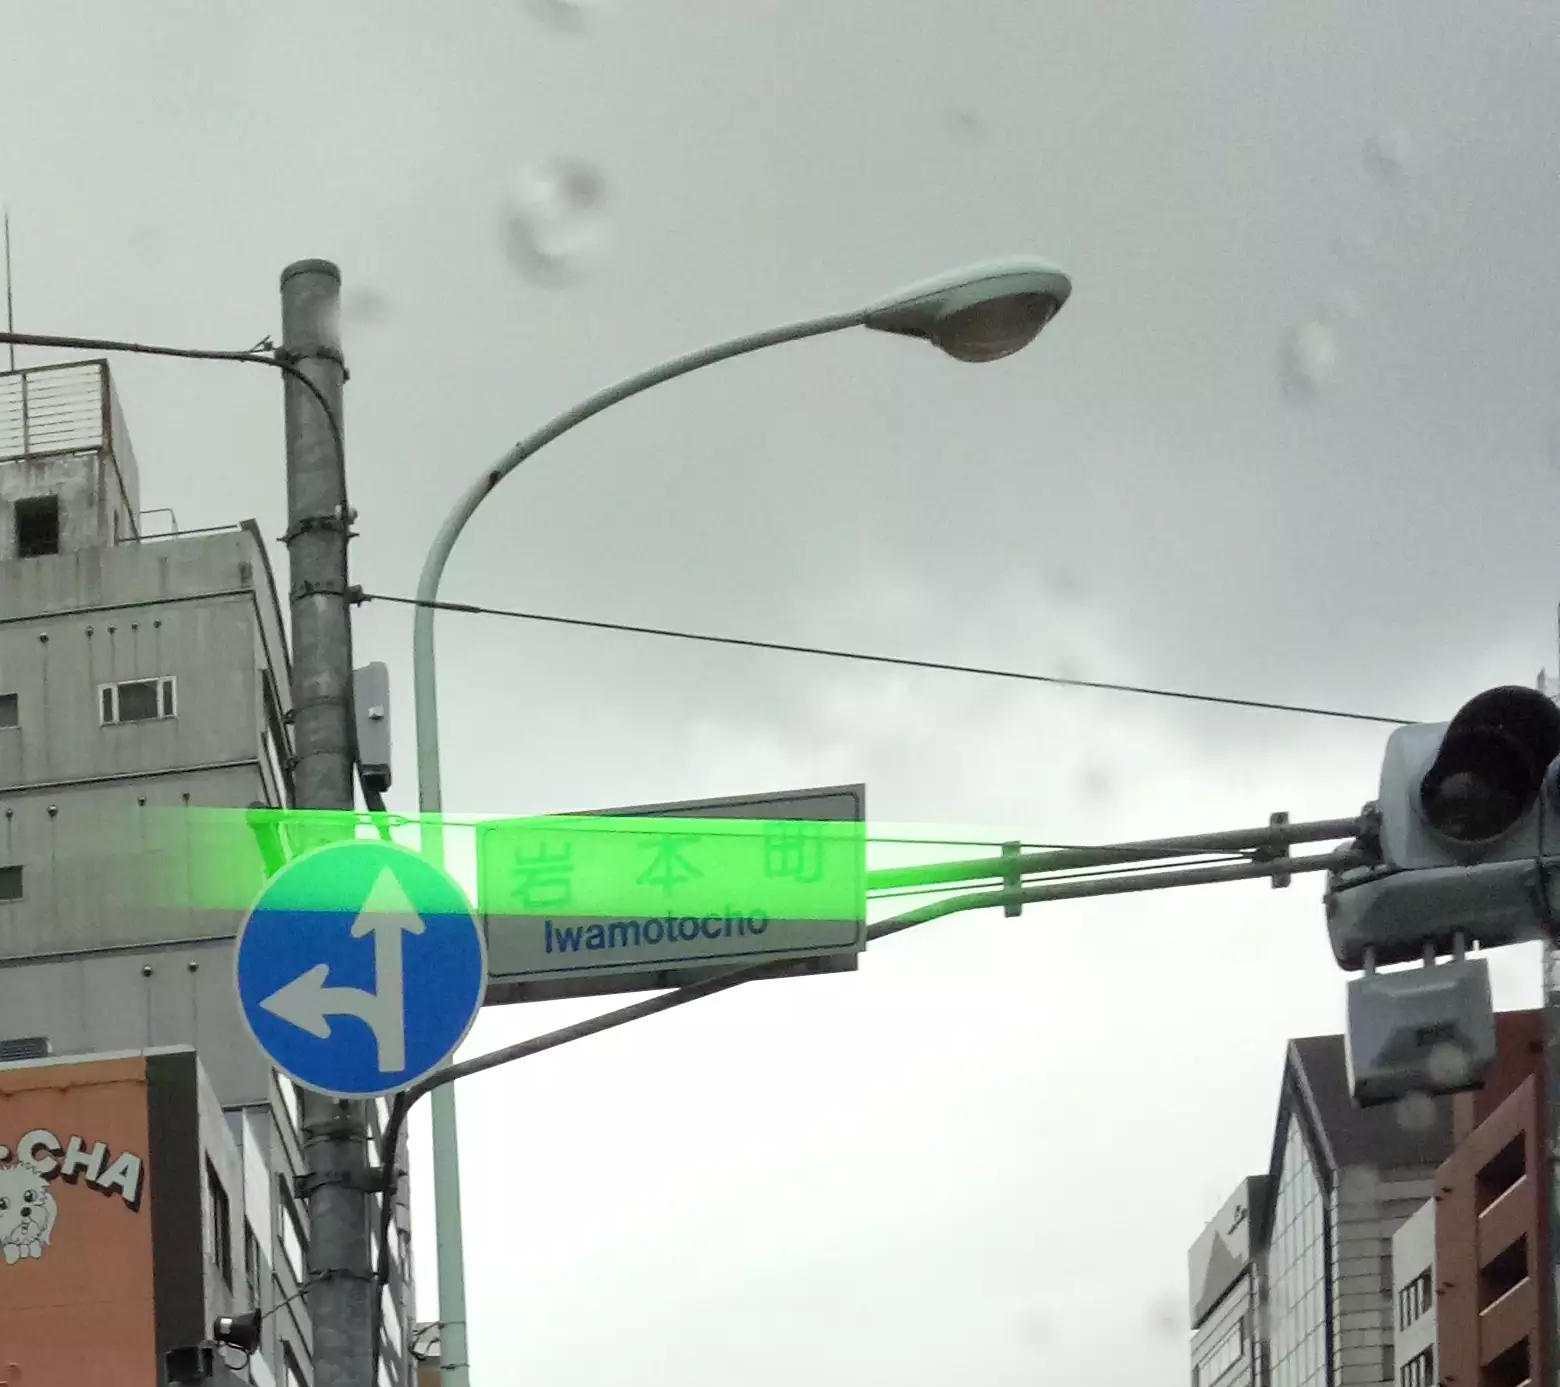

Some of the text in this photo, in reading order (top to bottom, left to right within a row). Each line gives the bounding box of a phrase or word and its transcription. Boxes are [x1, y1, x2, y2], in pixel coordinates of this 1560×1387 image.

[510, 820, 828, 909] 岩本町
[543, 906, 770, 954] Iwamotocho
